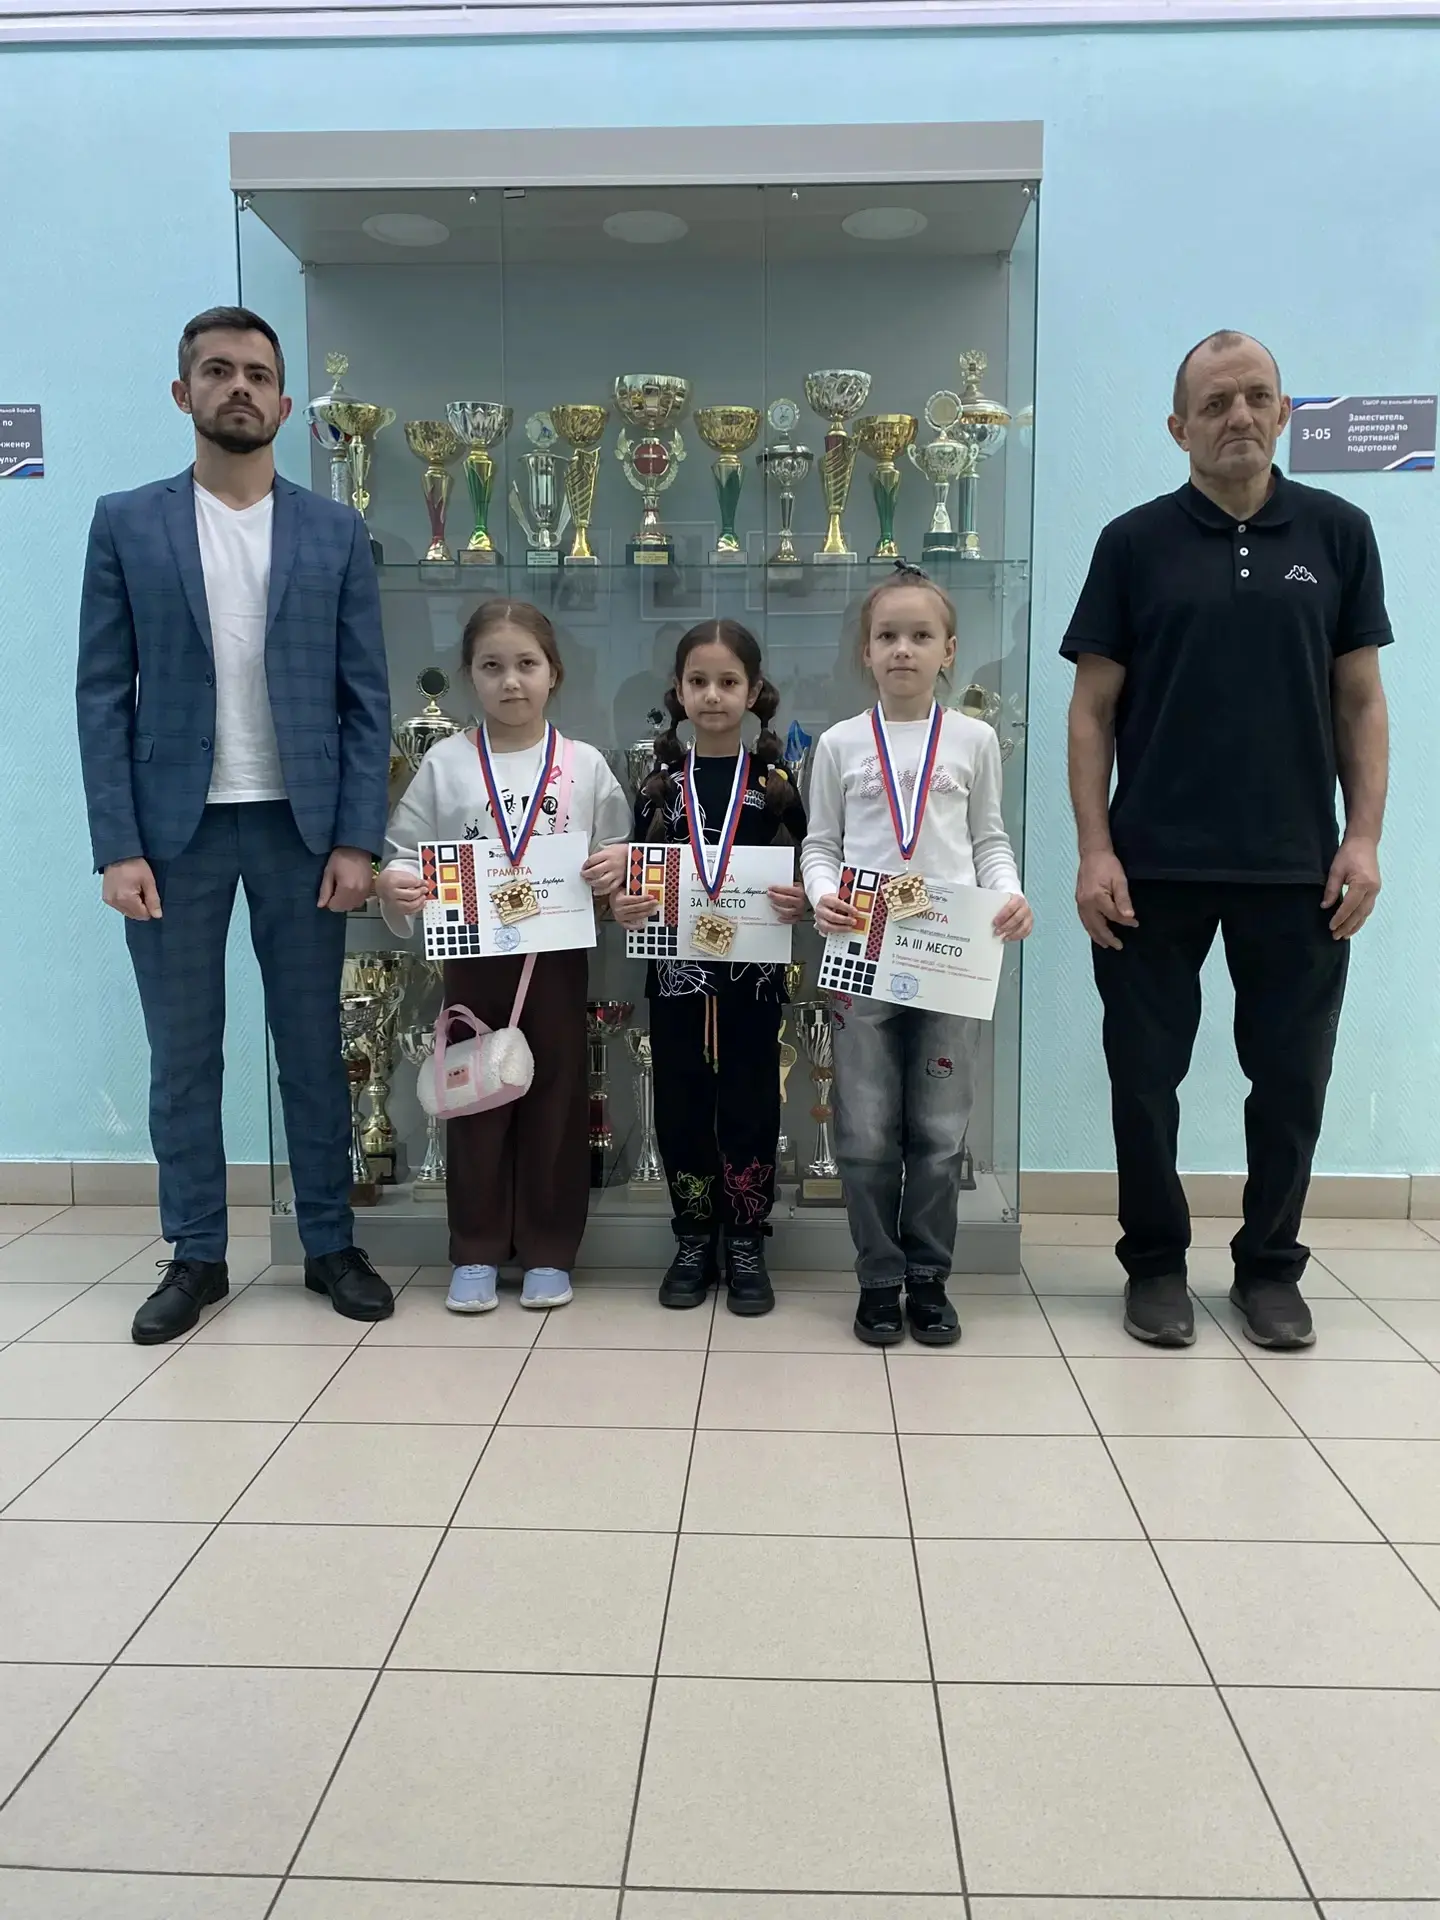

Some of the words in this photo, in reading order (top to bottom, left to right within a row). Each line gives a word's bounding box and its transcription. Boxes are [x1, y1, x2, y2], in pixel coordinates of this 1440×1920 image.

[1349, 413, 1404, 421] Заместитель
[1348, 424, 1395, 433] директора
[1302, 428, 1331, 440] 3-05
[1348, 433, 1400, 443] спортивной
[1347, 445, 1397, 453] подготовке
[487, 867, 532, 877] ГРАМОТА
[690, 897, 703, 907] ЗА
[713, 899, 746, 908] МЕСТО
[916, 889, 929, 906] 3
[523, 896, 537, 911] 2
[895, 935, 908, 947] ЗА
[912, 939, 922, 950] III
[925, 941, 963, 957] МЕСТО
